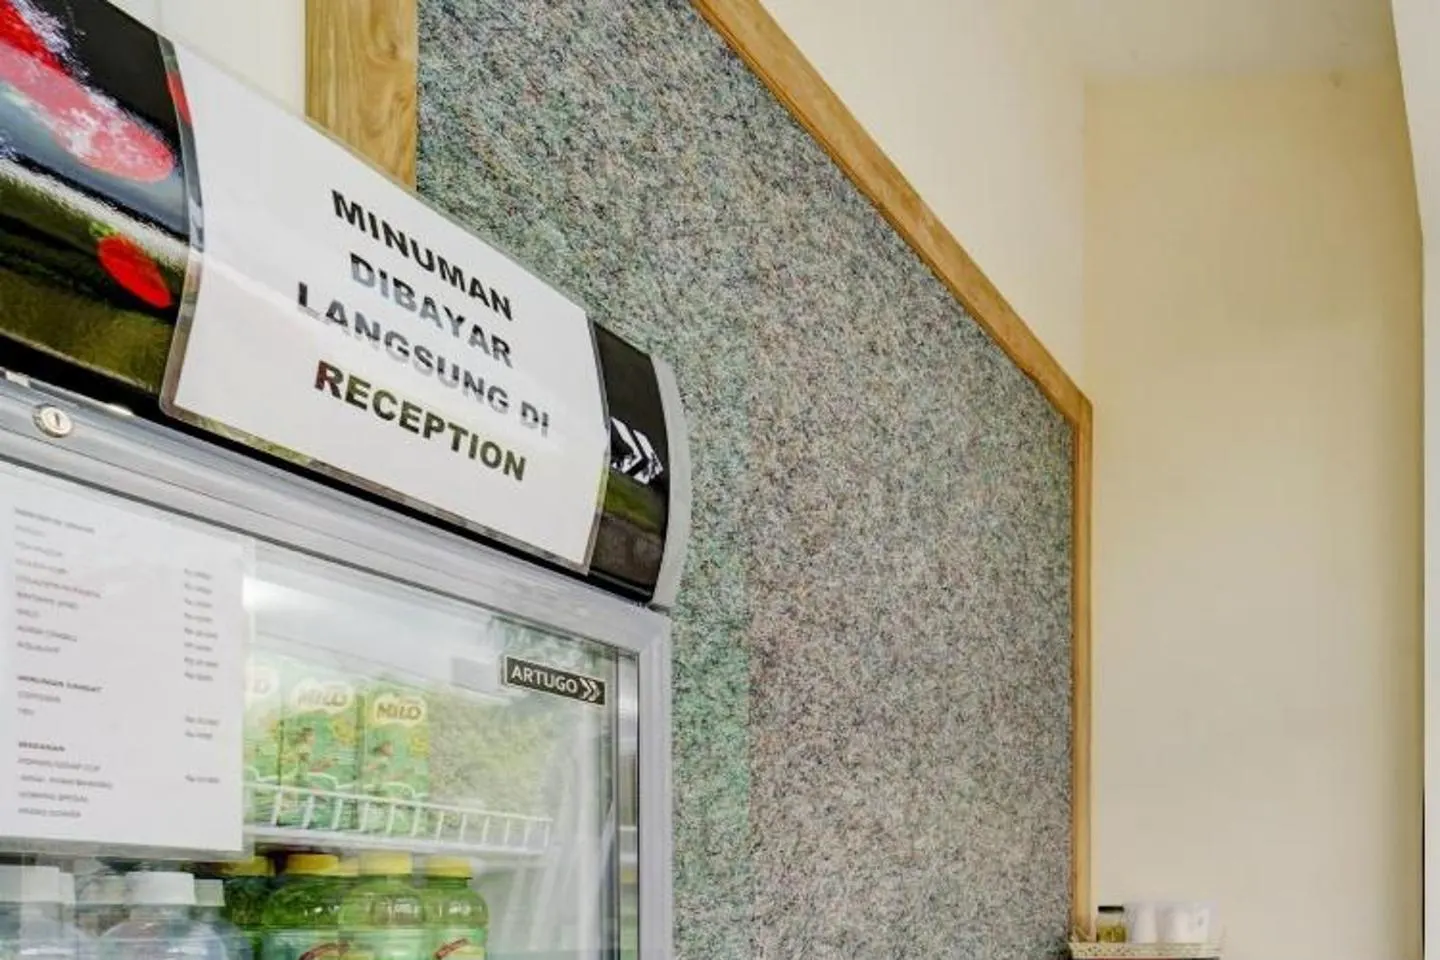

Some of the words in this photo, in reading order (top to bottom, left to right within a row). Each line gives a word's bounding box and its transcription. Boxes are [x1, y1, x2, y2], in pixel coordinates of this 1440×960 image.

[331, 187, 513, 321] MINUMAN
[349, 252, 513, 366] DIBAYAR
[296, 282, 511, 414] LANGSUNG
[520, 400, 549, 437] DI
[314, 360, 527, 483] RECEPTION
[376, 701, 422, 721] MILO
[511, 664, 578, 694] ARTUGO
